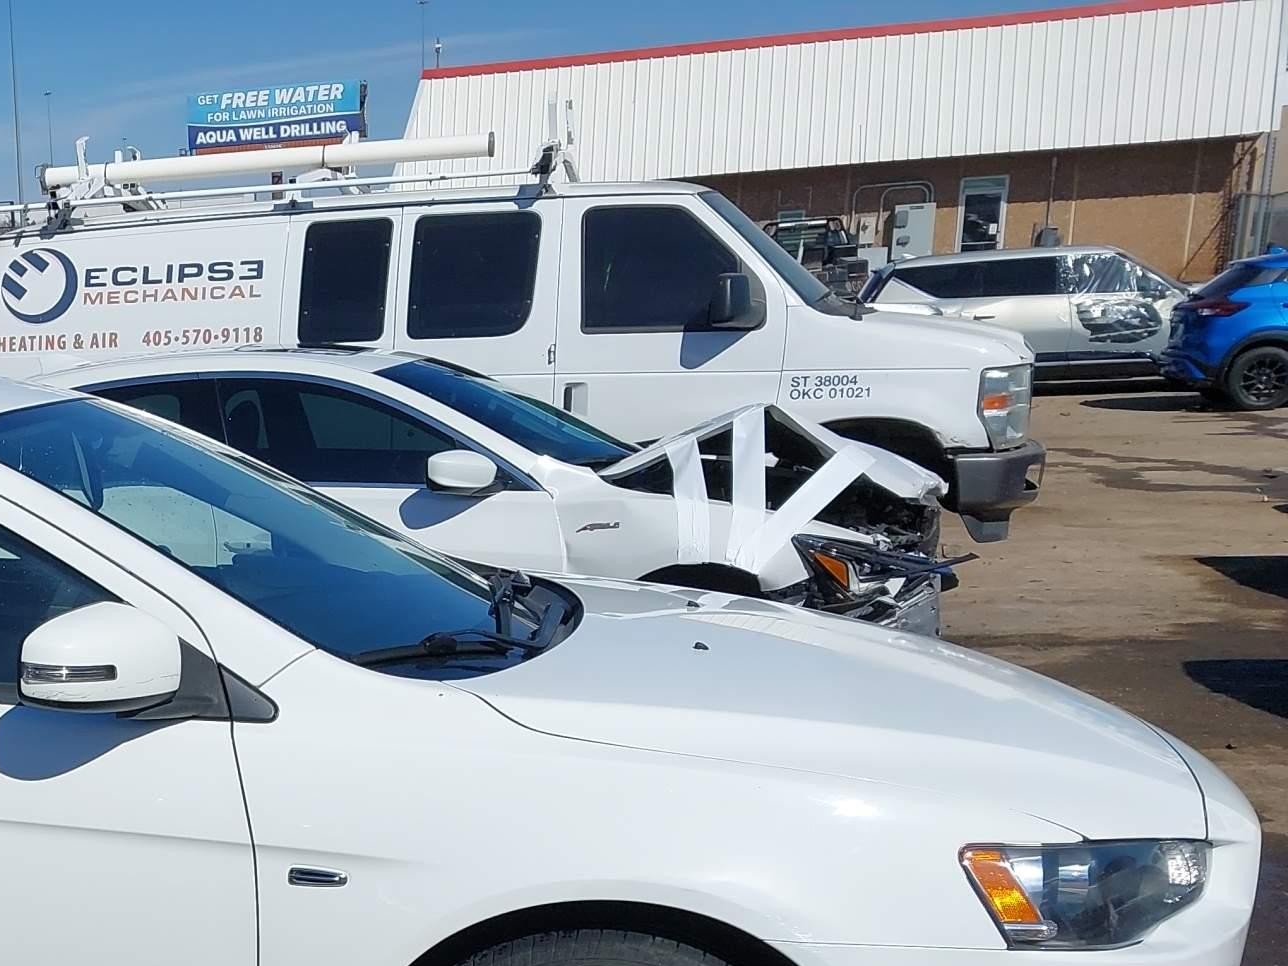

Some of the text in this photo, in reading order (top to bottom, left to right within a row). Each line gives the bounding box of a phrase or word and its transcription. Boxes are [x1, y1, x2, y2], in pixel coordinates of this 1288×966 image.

[197, 83, 344, 110] GET FREE WATER
[207, 102, 334, 123] FOR LAWN IRRIGATION
[195, 120, 347, 145] AQUA WELL DRILLING
[83, 285, 262, 305] MECHANICAL
[73, 333, 85, 349] &
[90, 332, 119, 348] AIR
[790, 375, 858, 388] ST 38004
[789, 387, 872, 400] OKC 01021
